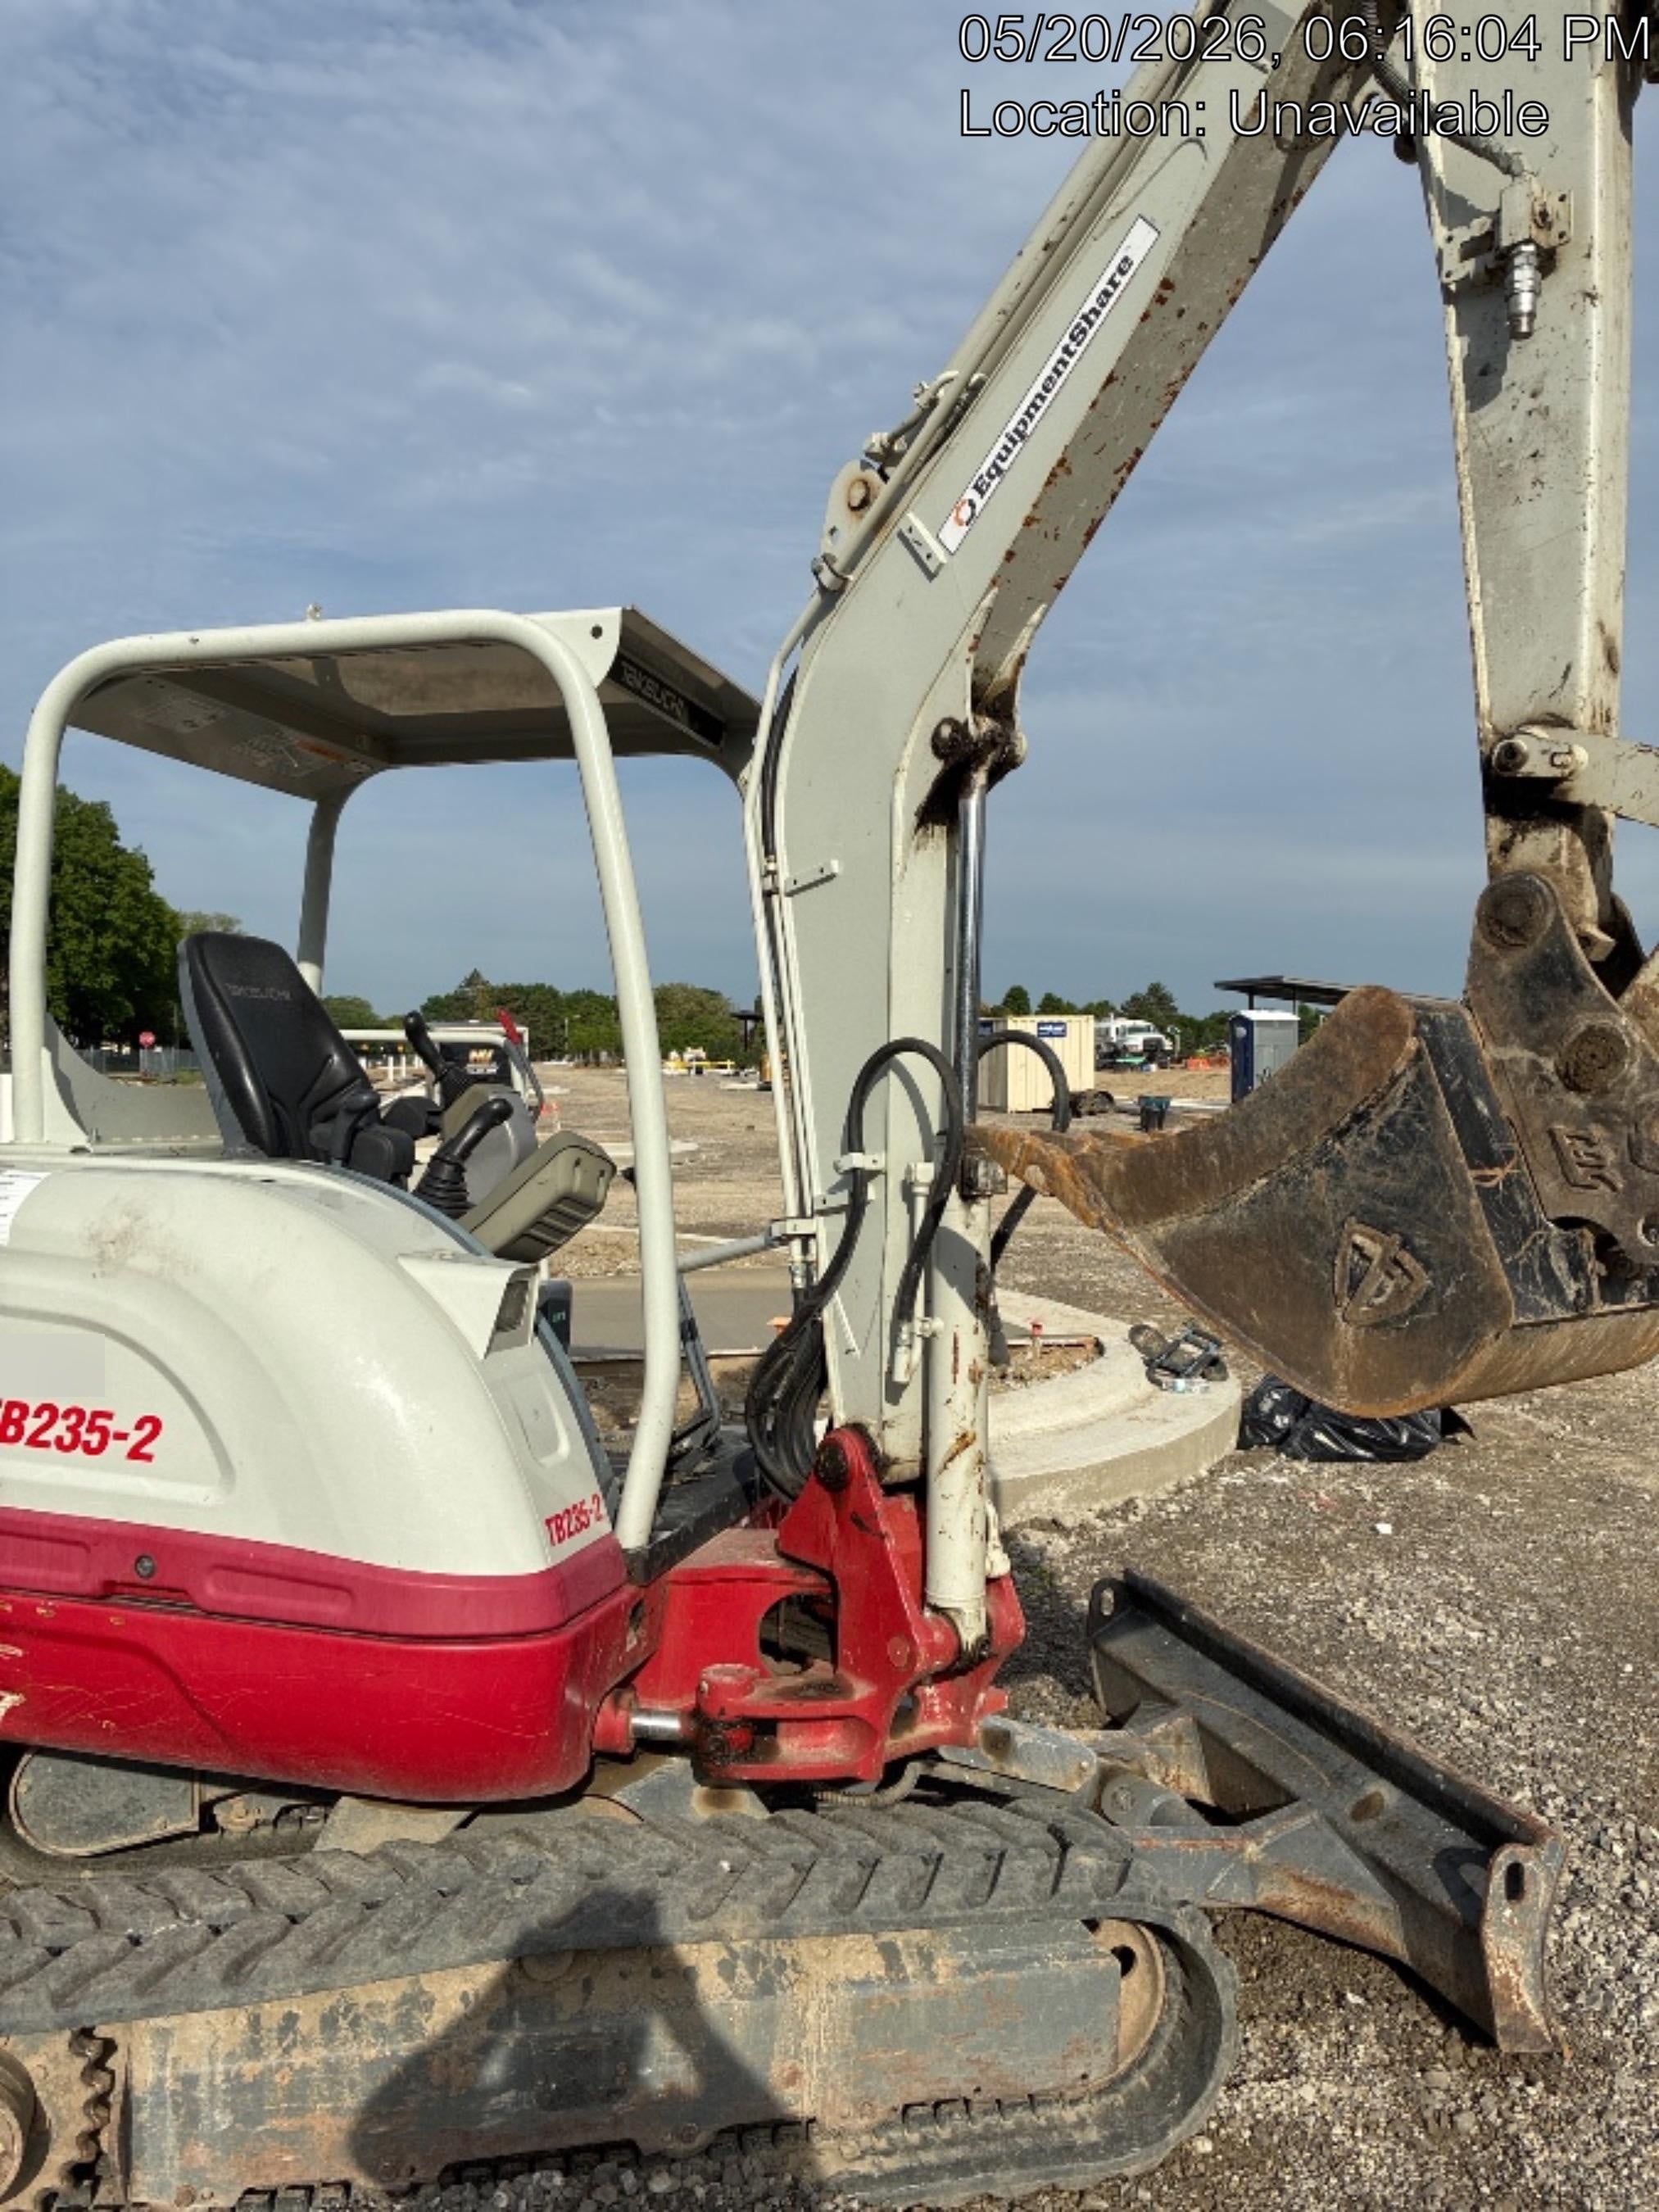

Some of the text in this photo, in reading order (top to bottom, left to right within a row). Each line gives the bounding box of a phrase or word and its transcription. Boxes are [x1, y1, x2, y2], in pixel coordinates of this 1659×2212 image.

[972, 255, 1134, 499] EquipmentShare
[0, 1398, 164, 1463] B235-2
[545, 1493, 603, 1547] TB235-2
